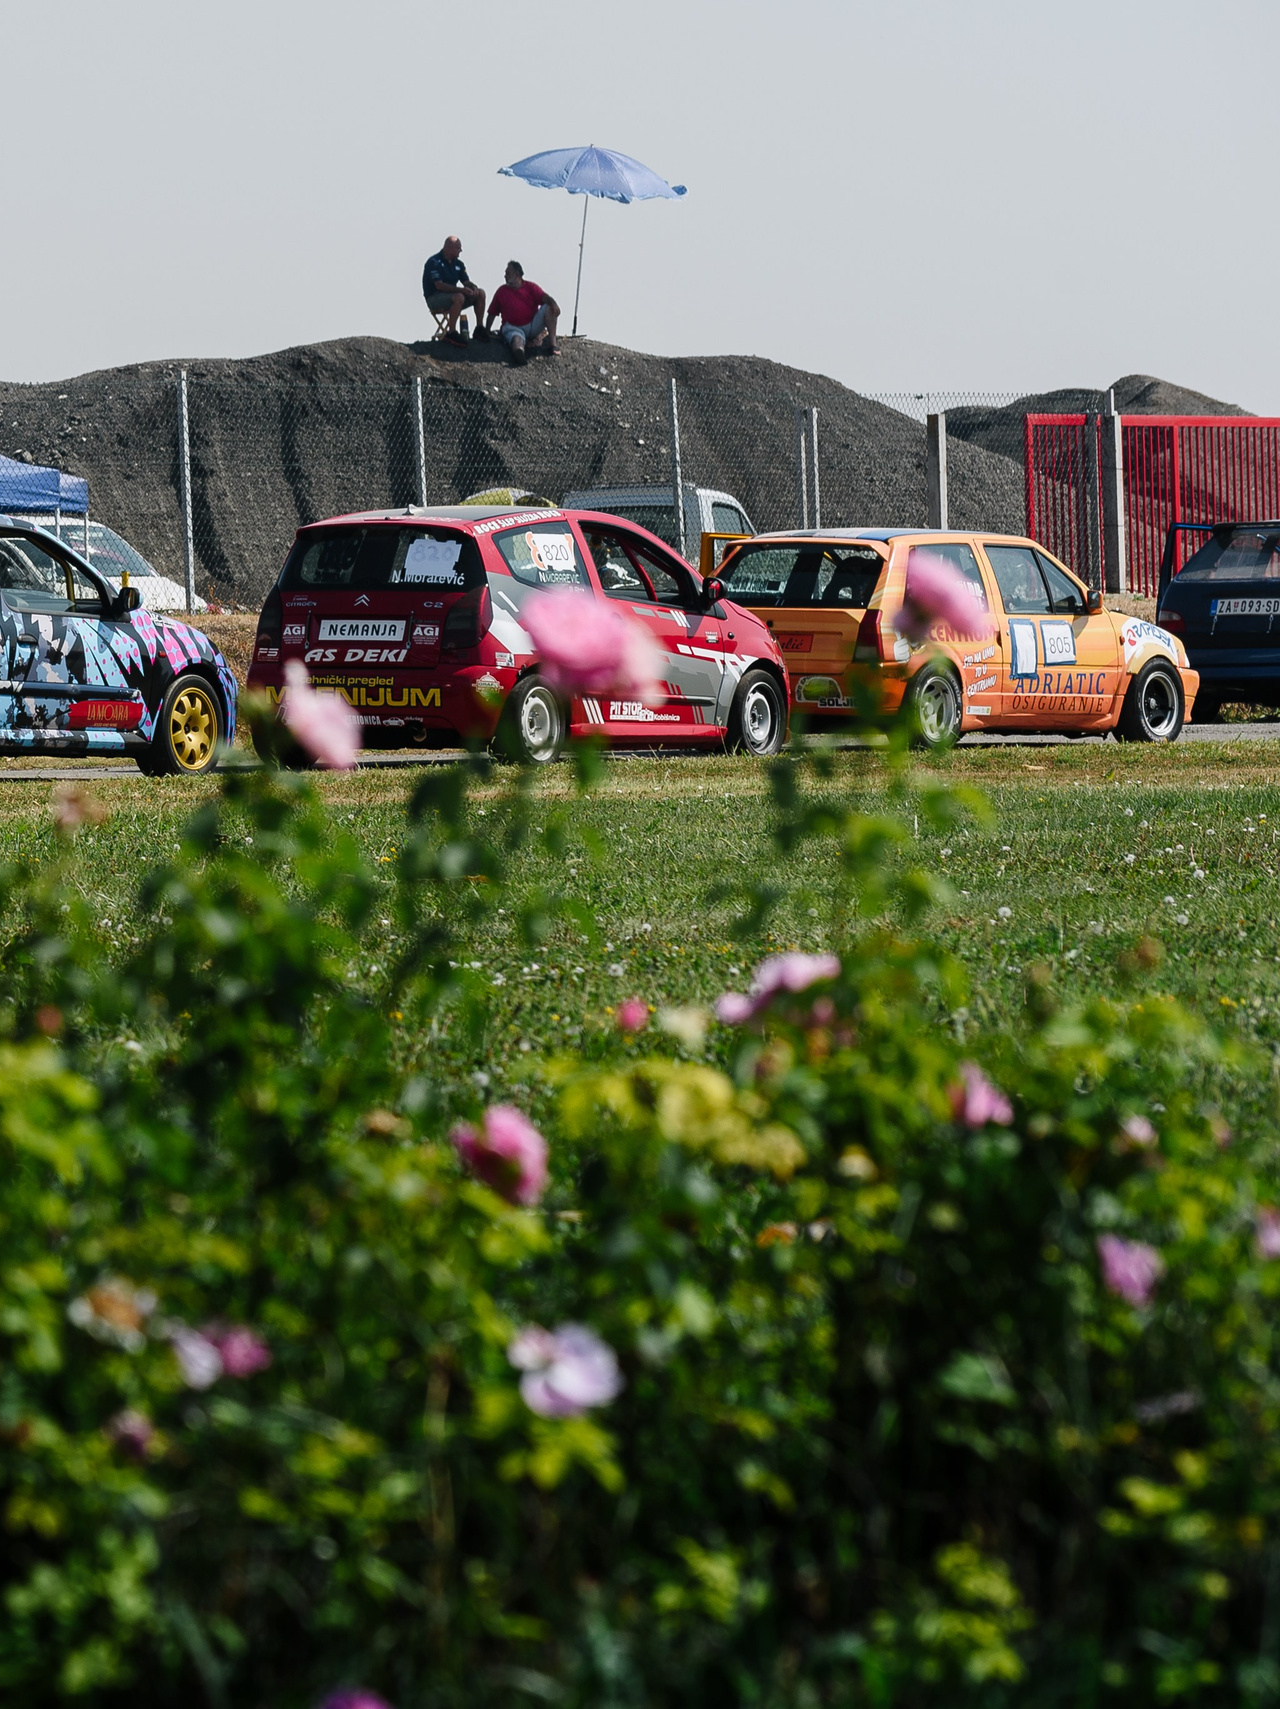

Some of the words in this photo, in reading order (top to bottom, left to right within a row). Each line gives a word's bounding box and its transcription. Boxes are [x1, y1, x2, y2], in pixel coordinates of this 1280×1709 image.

[543, 544, 569, 561] 820
[1218, 601, 1232, 613] ZA
[283, 626, 306, 635] AGI
[328, 624, 397, 636] NEMANJA
[412, 627, 440, 636] AGI
[1048, 637, 1071, 654] 805
[304, 649, 338, 662] AS
[344, 649, 408, 662] DEKI
[301, 674, 346, 685] ehnički
[347, 676, 394, 687] pregled
[1013, 672, 1107, 695] ADRIATIC
[265, 686, 442, 707] MENIJUM
[610, 701, 621, 715] PIT
[622, 701, 642, 715] STOP
[1012, 695, 1104, 714] OSIGURANJE
[96, 704, 129, 721] MOARA
